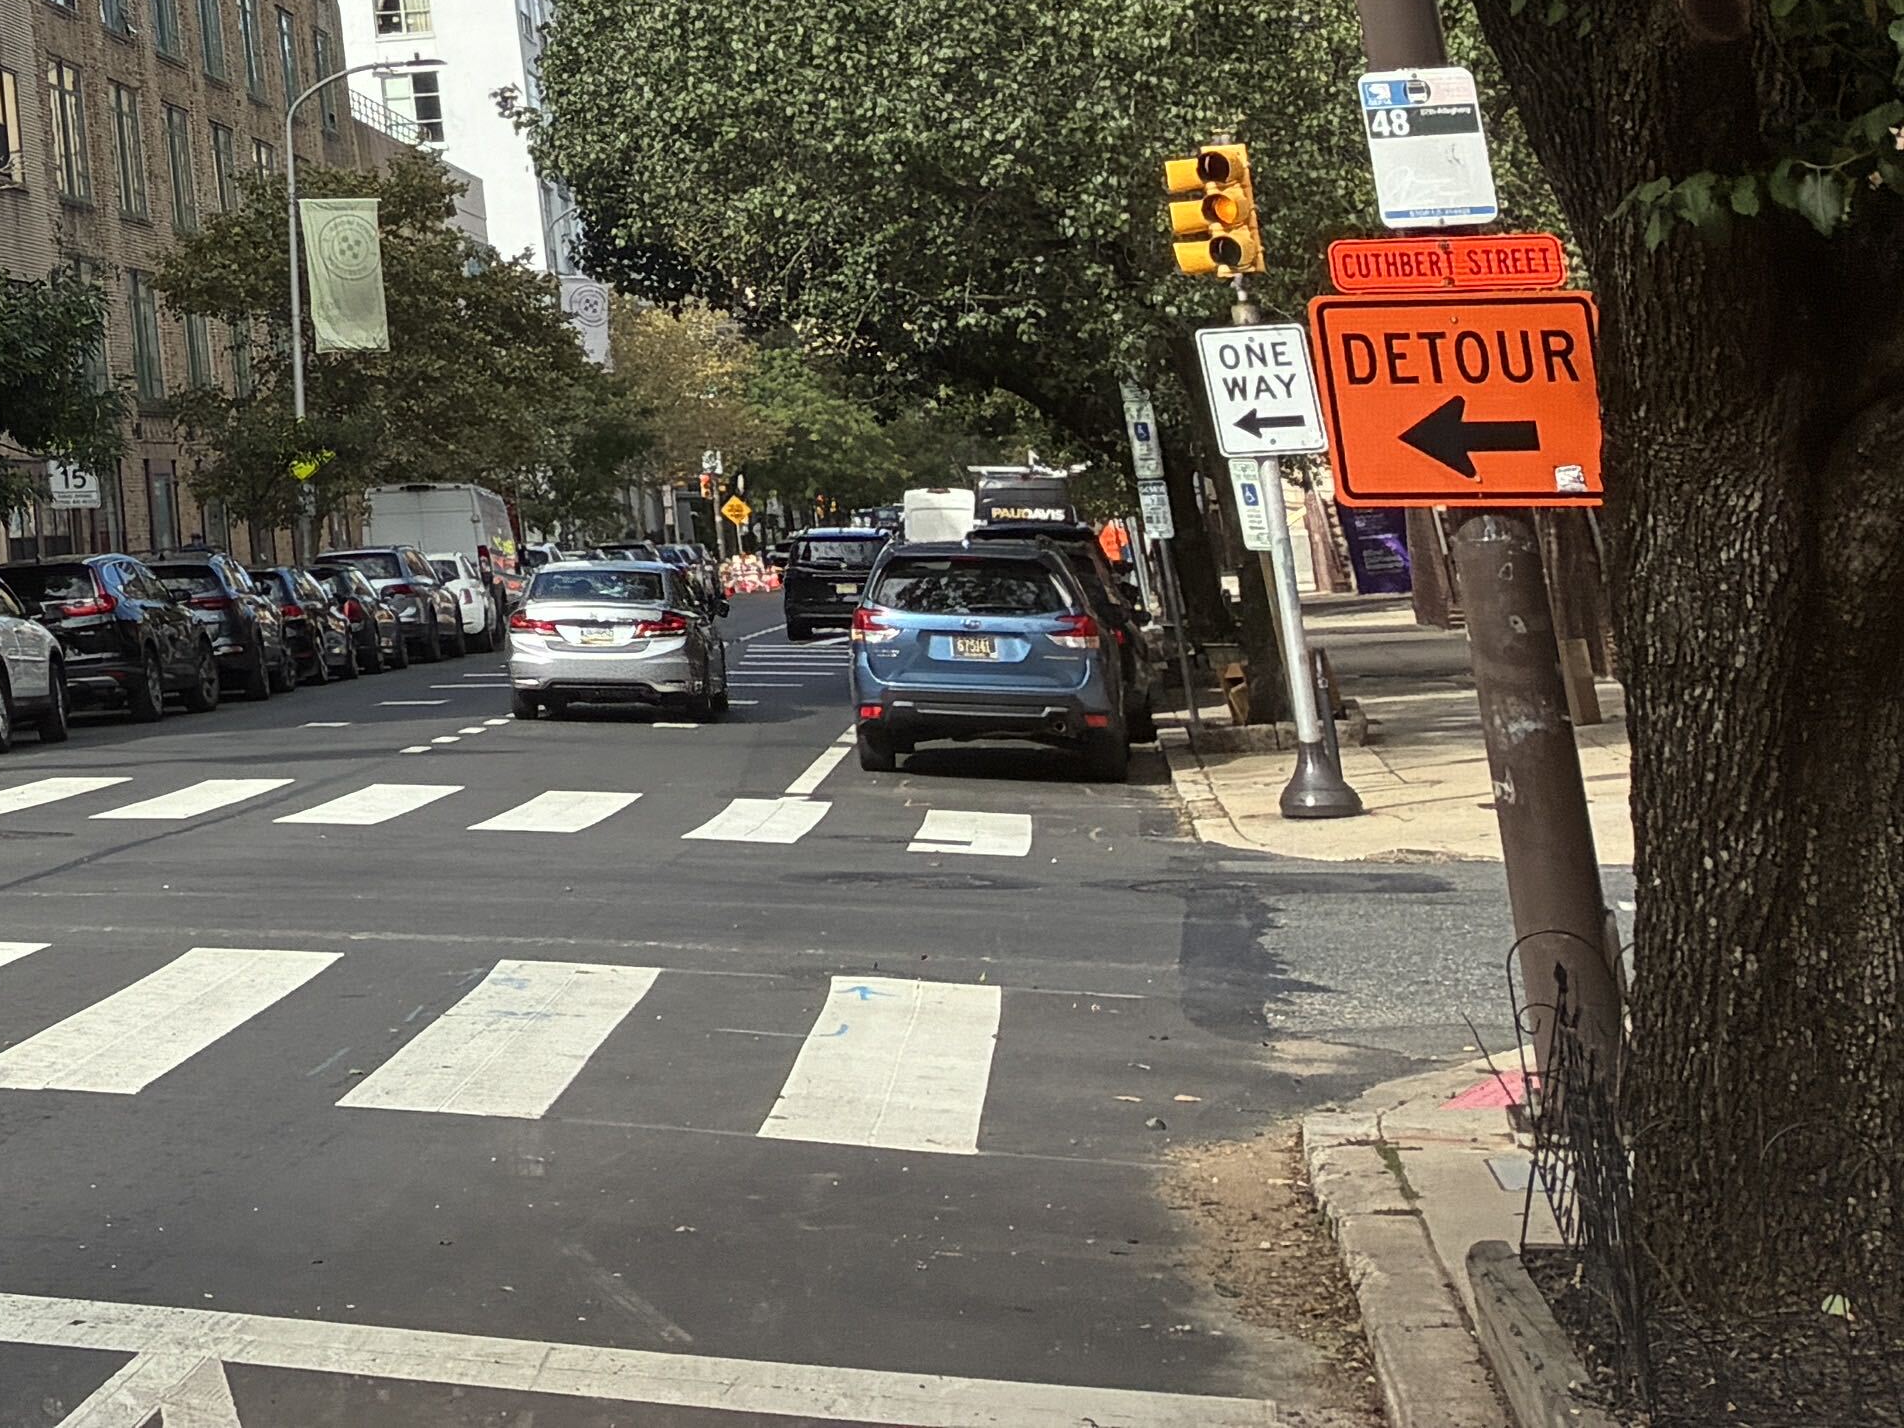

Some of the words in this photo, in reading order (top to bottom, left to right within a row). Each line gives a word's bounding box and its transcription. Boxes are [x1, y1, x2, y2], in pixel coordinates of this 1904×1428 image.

[1371, 109, 1410, 137] 48
[1341, 250, 1454, 279] CUTHBERT
[1466, 246, 1552, 275] STREET
[1219, 340, 1293, 370] ONE
[1341, 329, 1580, 386] DETOUR
[1221, 372, 1297, 402] WAY
[55, 460, 87, 490] 15
